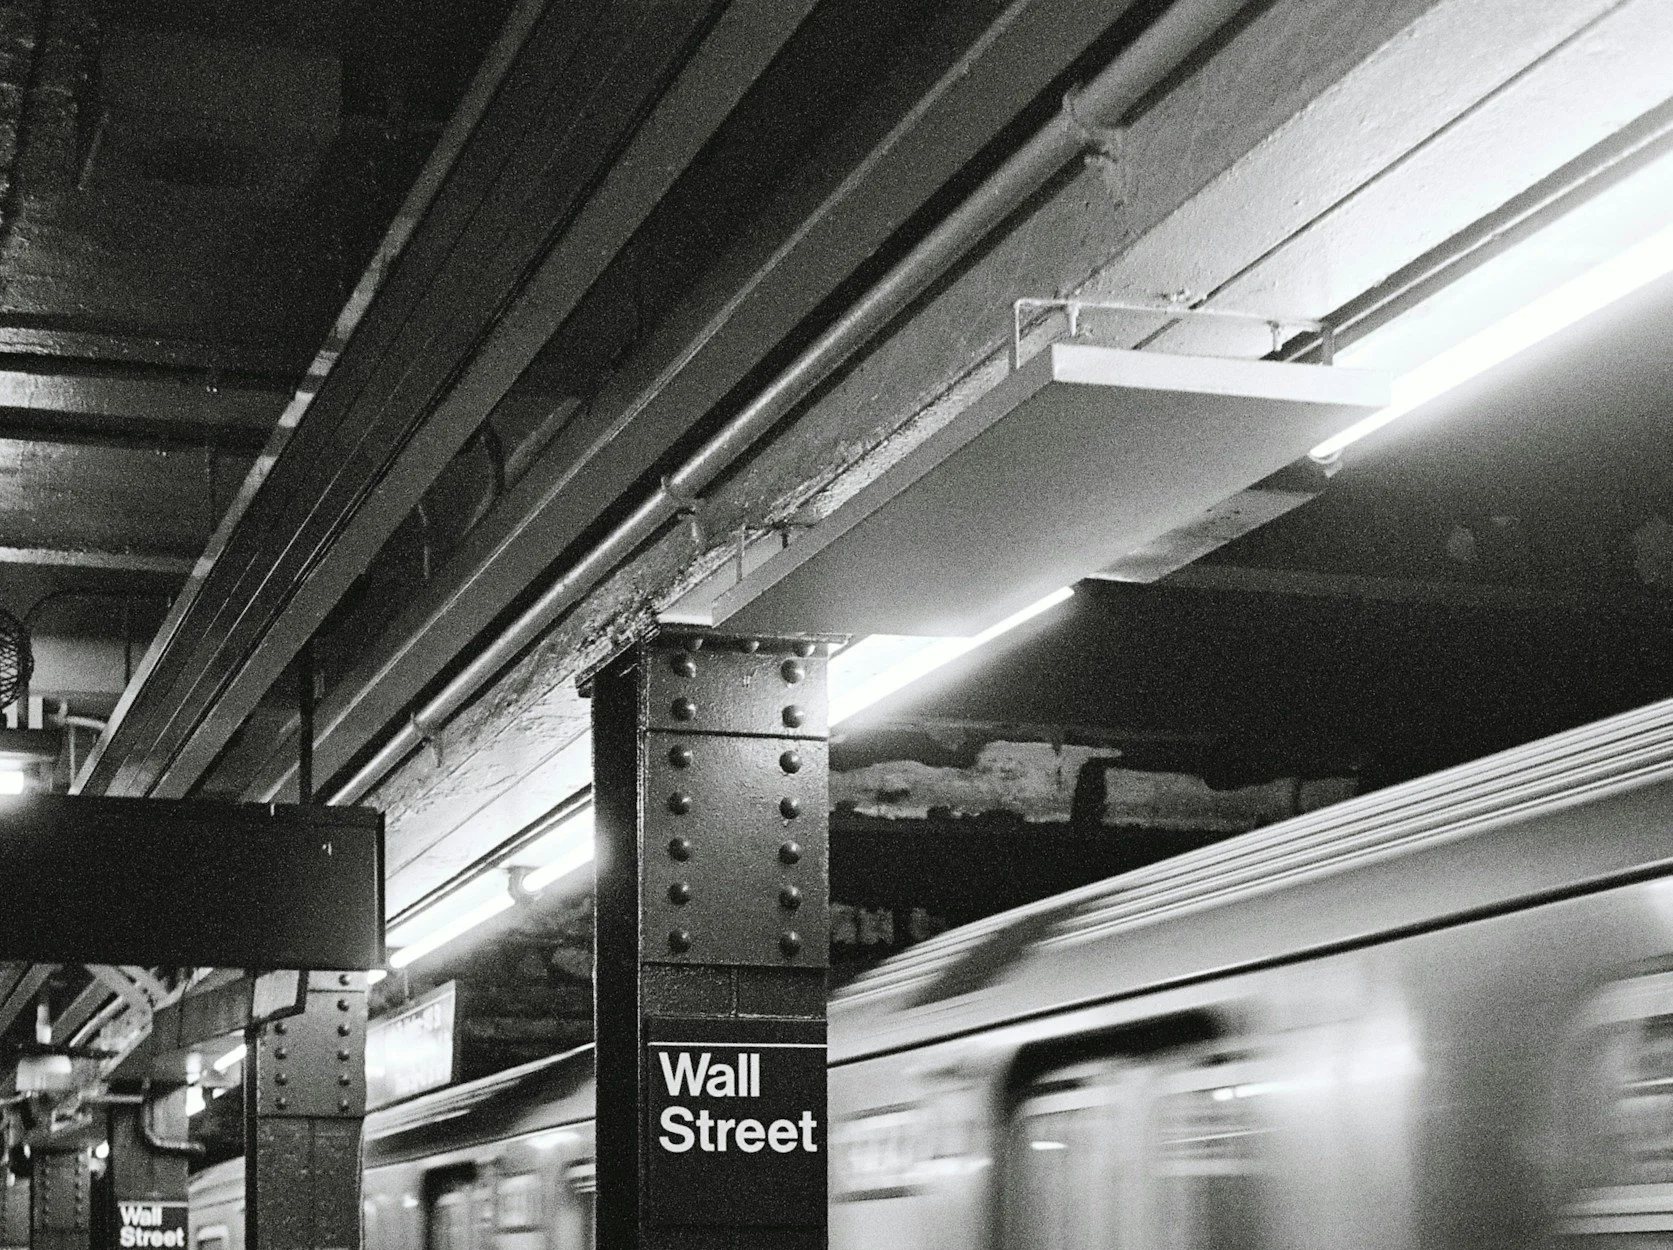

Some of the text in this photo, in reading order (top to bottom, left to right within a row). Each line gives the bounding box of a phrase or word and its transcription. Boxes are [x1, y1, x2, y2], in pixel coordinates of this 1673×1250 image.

[658, 1051, 760, 1098] Wall
[658, 1105, 818, 1153] Street
[120, 1204, 163, 1227] Wall
[120, 1225, 185, 1248] Street
